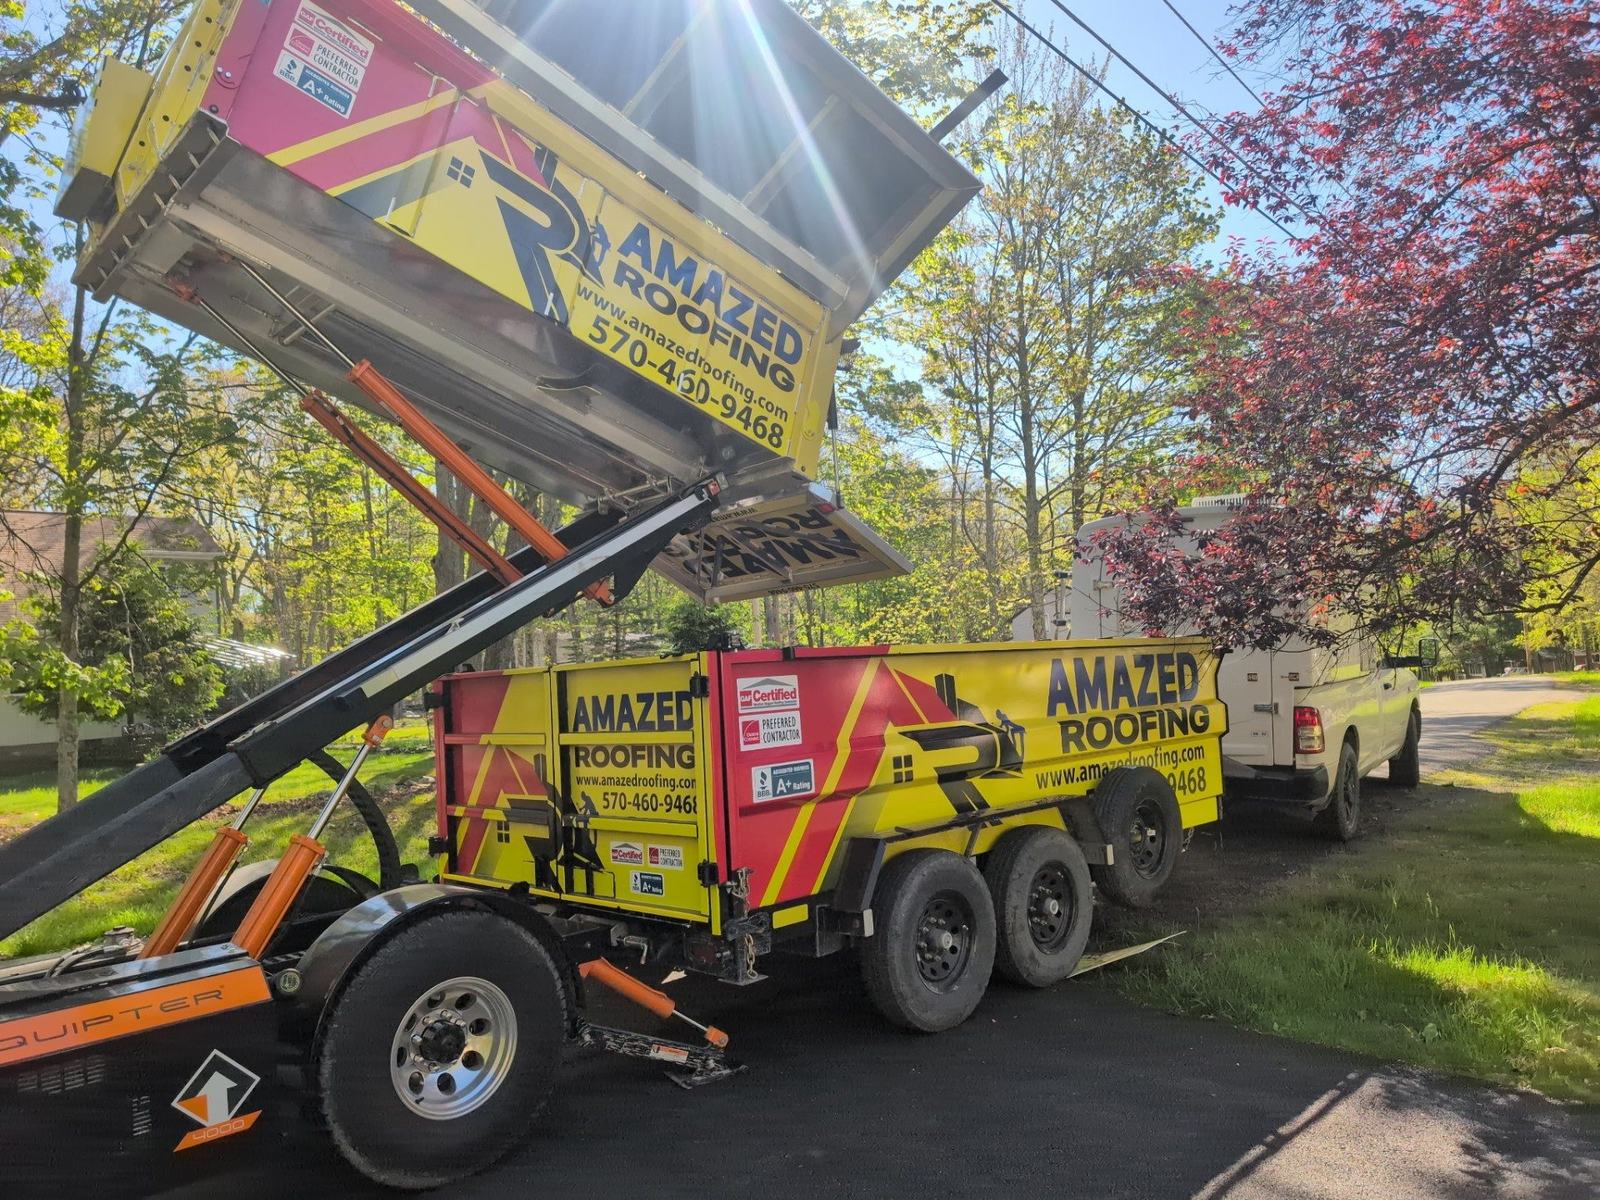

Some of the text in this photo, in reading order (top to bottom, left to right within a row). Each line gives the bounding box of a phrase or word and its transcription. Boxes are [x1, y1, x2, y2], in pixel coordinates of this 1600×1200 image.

[315, 18, 369, 58] Certified
[313, 54, 359, 88] CONTRACTOR
[316, 44, 358, 76] PREFERRED
[303, 79, 346, 113] A+ Rating
[617, 222, 803, 365] AMAZED
[613, 260, 796, 393] ROOFING
[576, 282, 788, 423] www.amazedroofing.com
[588, 315, 784, 449] 570-460-9468
[753, 688, 797, 702] Certified
[1047, 652, 1199, 717] AMAZED
[573, 691, 693, 732] AMAZED
[762, 716, 796, 730] PREFERRED
[763, 729, 800, 744] CONTRACTOR
[1058, 704, 1210, 754] ROOFING
[575, 744, 696, 770] ROOFING
[757, 789, 770, 798] BBB
[776, 778, 792, 794] A+
[618, 849, 643, 860] Certified
[192, 1118, 245, 1142] 4000
